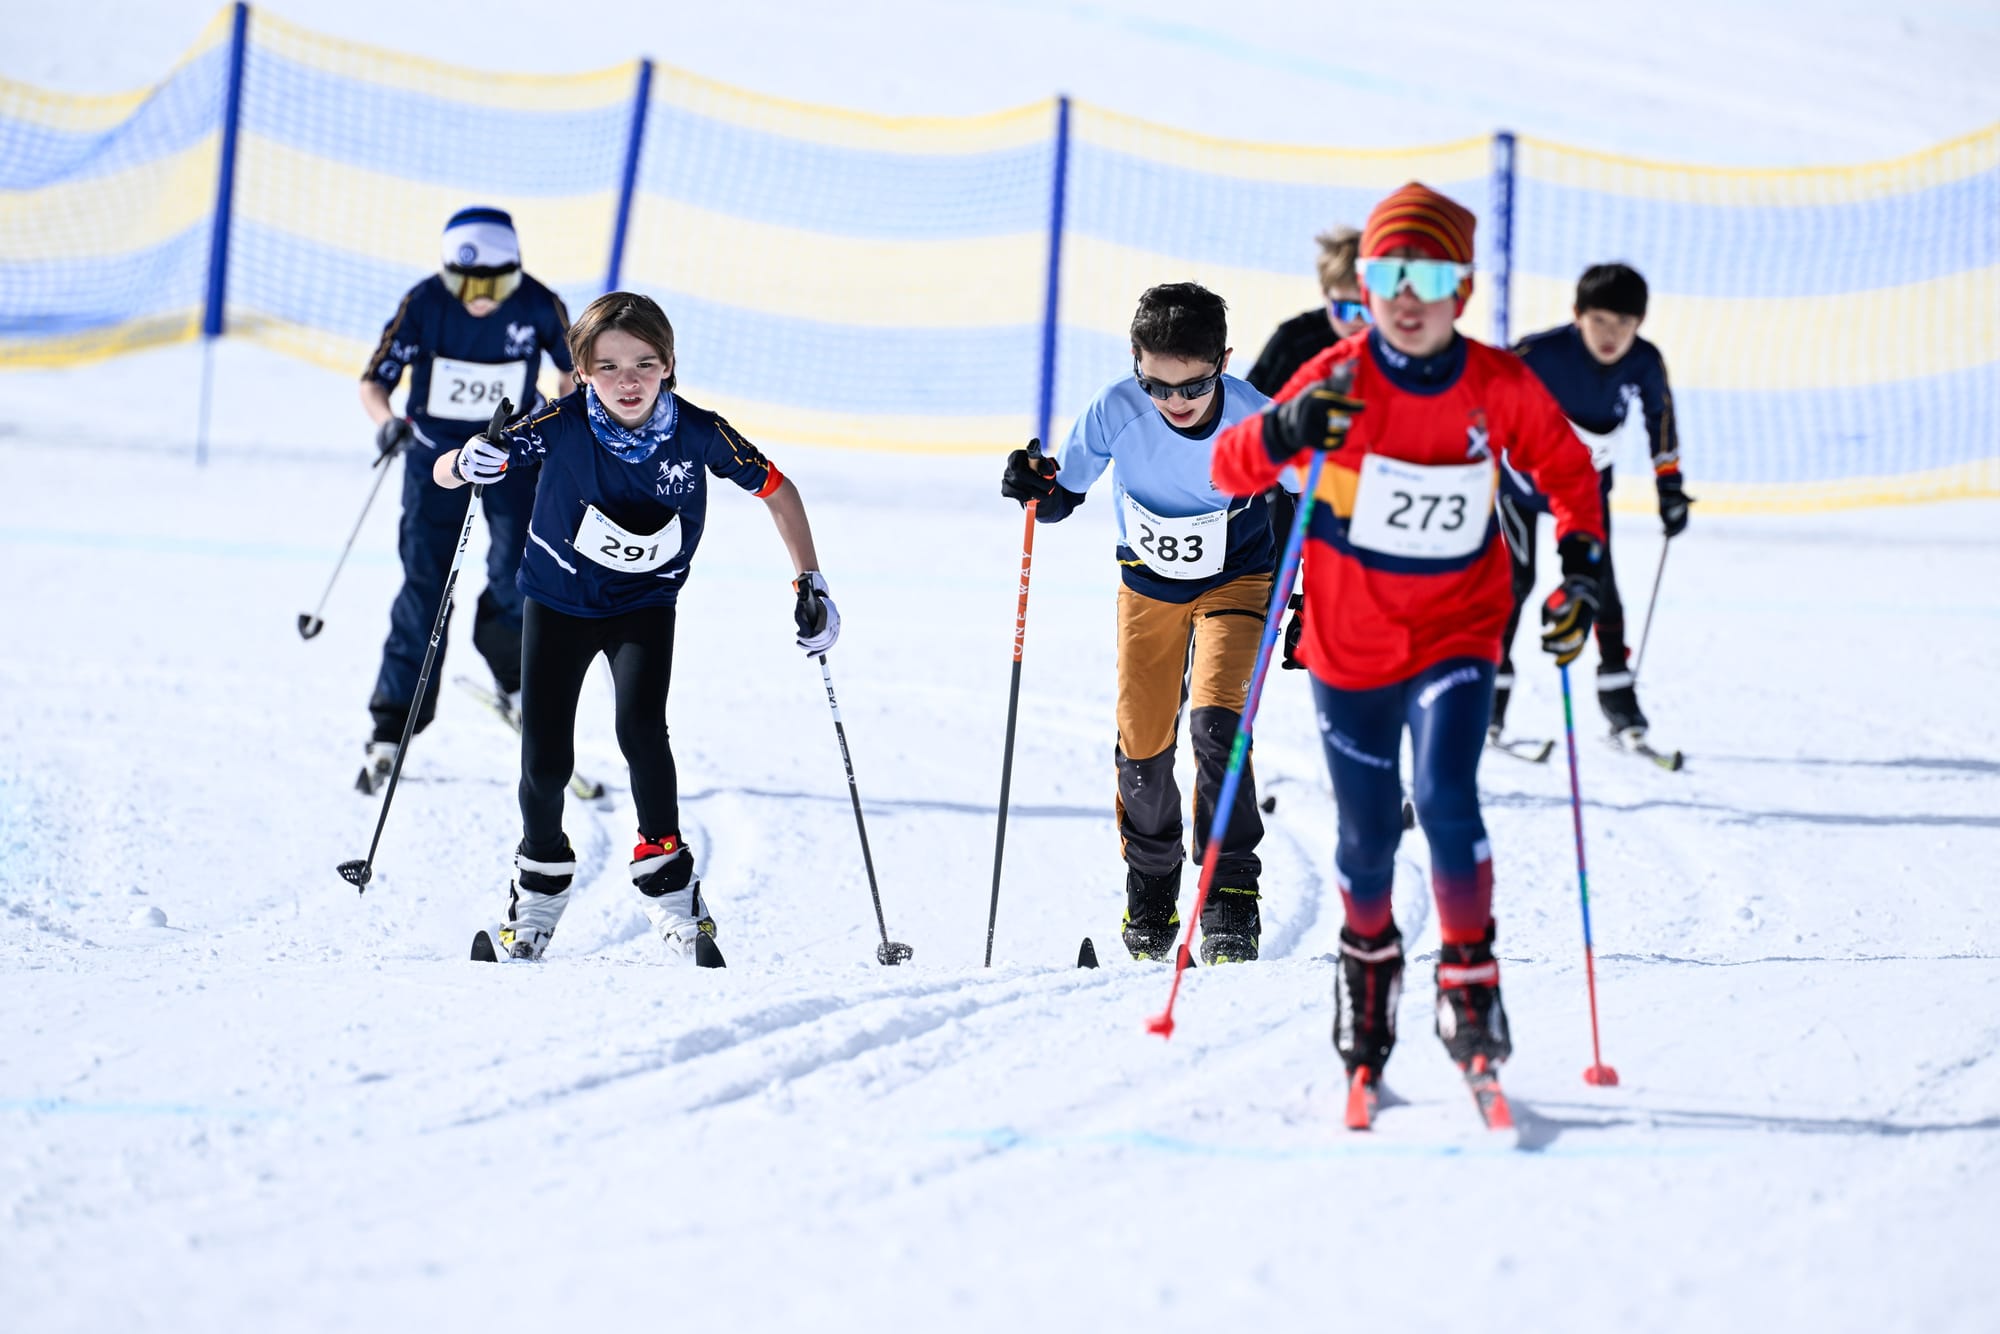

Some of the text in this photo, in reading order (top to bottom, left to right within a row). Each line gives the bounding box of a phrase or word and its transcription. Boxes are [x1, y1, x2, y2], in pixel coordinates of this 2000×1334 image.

[449, 378, 504, 403] 298
[656, 481, 695, 495] MGS
[1386, 491, 1467, 531] 273
[460, 515, 475, 553] LEKI
[600, 535, 659, 561] 291
[1140, 523, 1203, 562] 283
[1013, 551, 1031, 656] ONE WAY
